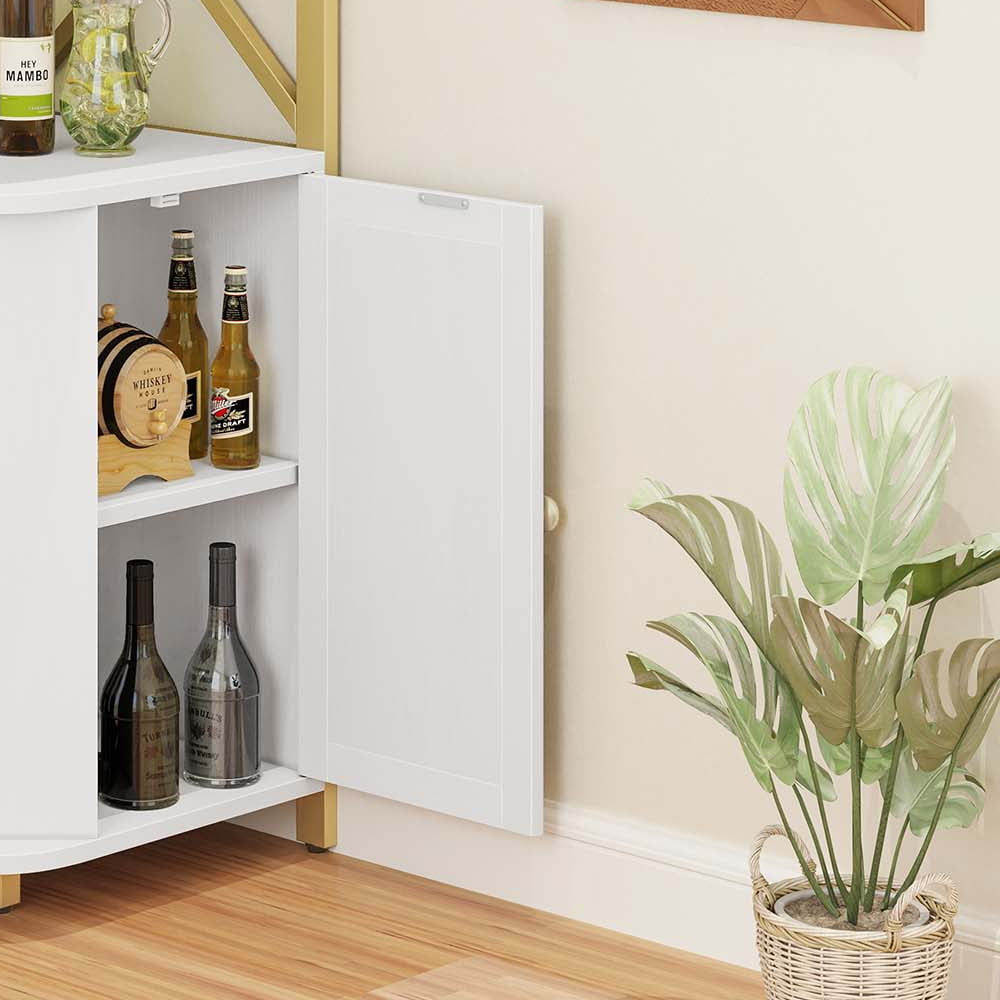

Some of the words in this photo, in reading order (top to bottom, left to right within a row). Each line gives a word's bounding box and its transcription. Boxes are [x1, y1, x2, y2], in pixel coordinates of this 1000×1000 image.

[20, 60, 37, 69] HEY
[6, 69, 49, 82] MAMBO
[132, 373, 172, 391] WHISKEY
[139, 386, 165, 398] HOUSE
[222, 418, 247, 428] DRAFT
